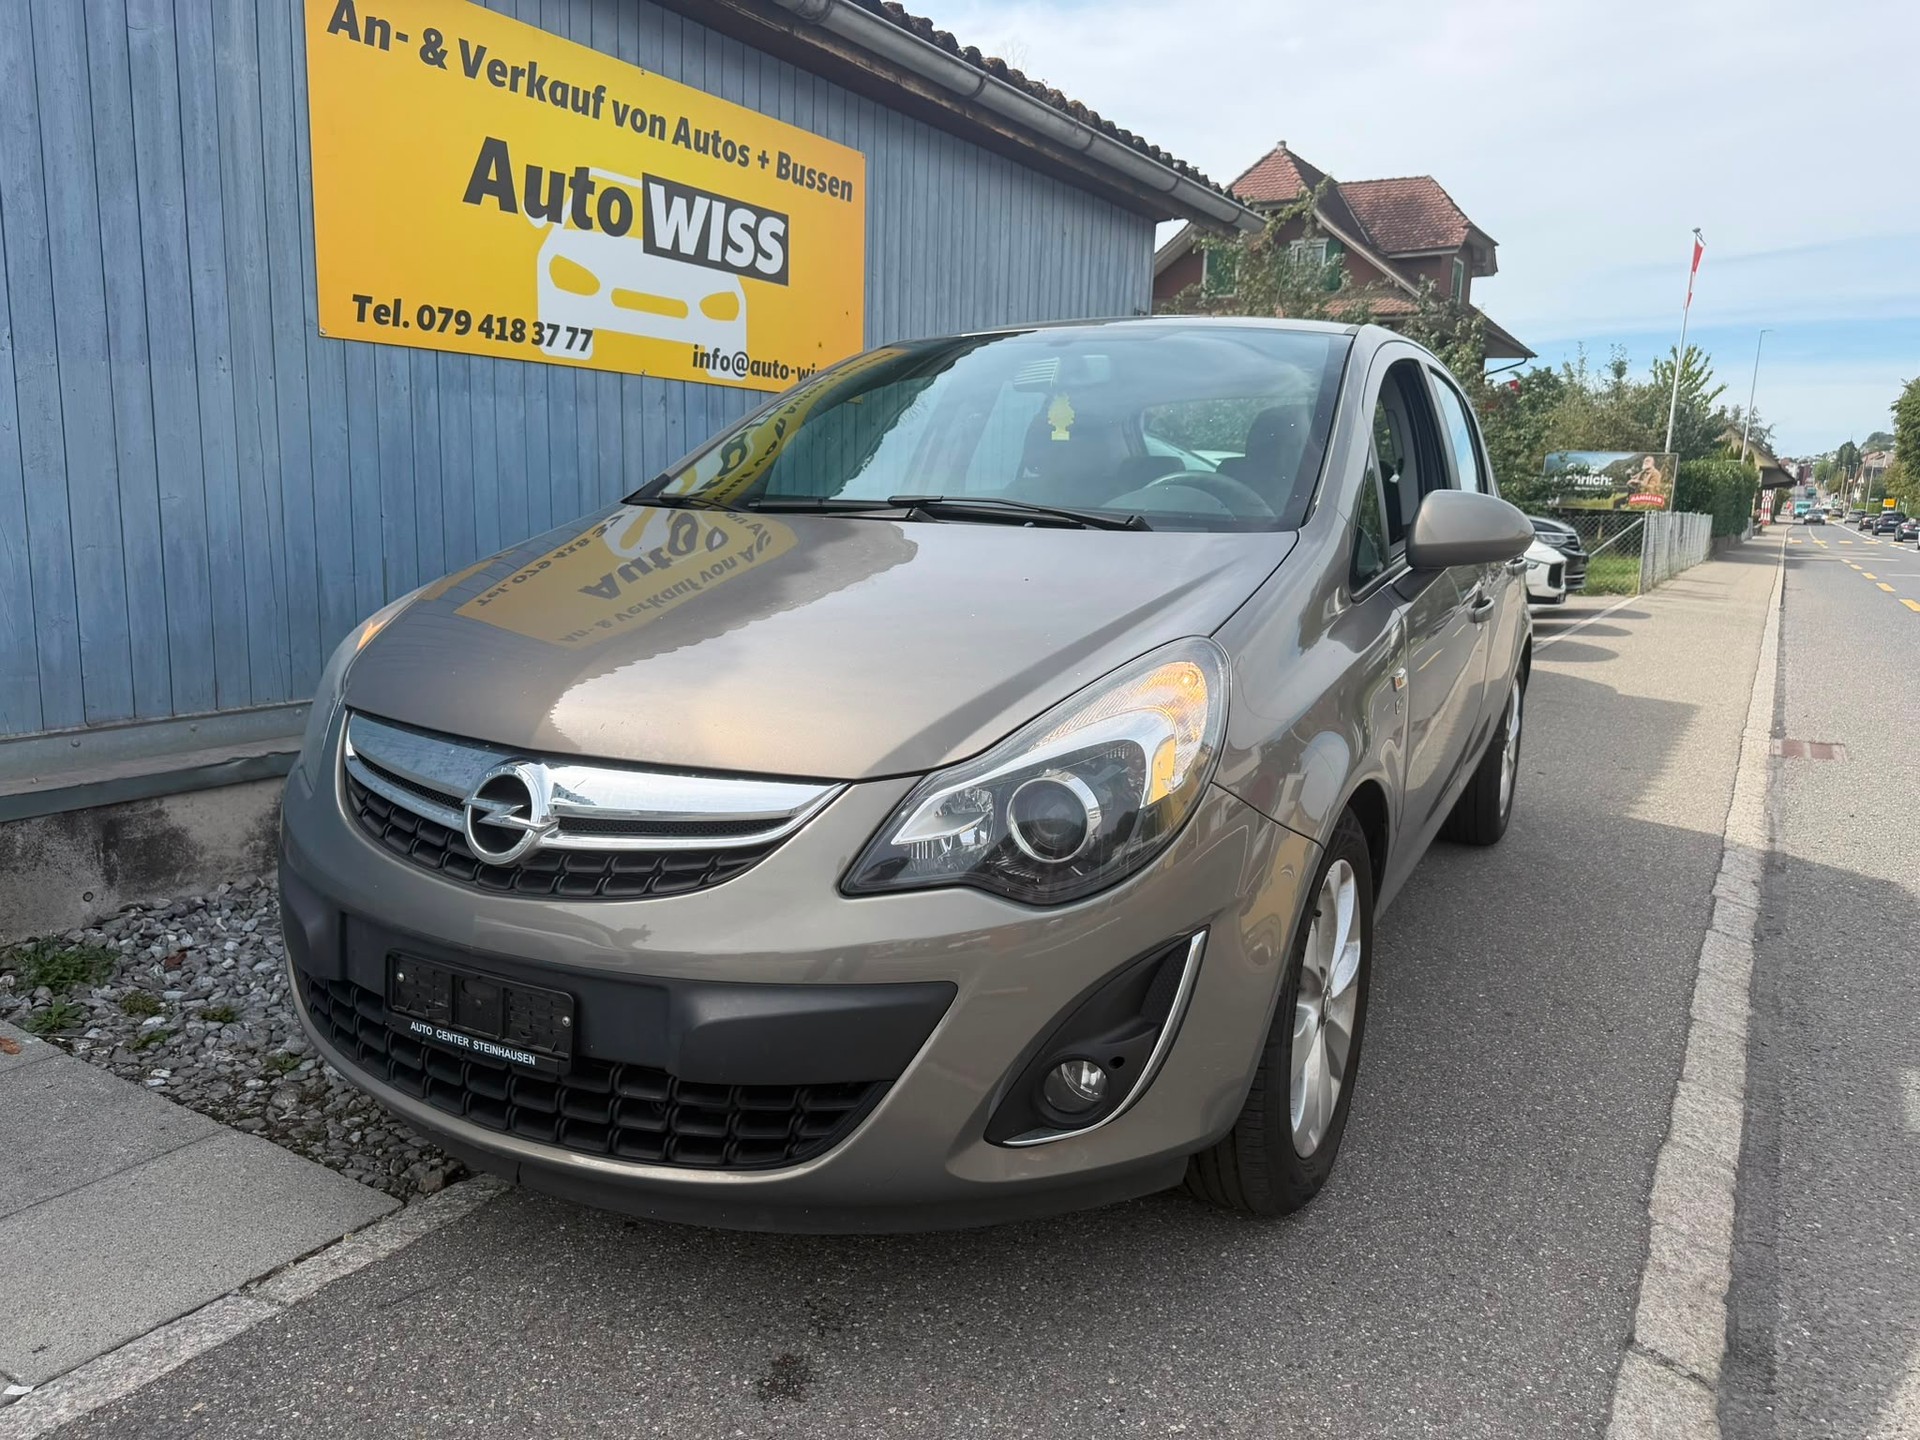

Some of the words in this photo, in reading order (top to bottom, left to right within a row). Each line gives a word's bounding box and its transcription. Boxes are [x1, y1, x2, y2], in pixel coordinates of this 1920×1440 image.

[327, 0, 408, 51] An-
[419, 28, 448, 70] &
[458, 38, 606, 119] Verkauf
[612, 99, 666, 141] von
[672, 116, 750, 168] Autos
[757, 150, 769, 170] +
[776, 151, 853, 202] Bussen
[462, 136, 633, 237] Auto
[648, 182, 786, 275] WISS
[352, 294, 410, 329] Tel.
[416, 304, 472, 336] 079
[478, 314, 527, 343] 418
[531, 321, 560, 347] 37
[565, 326, 593, 352] 77
[692, 344, 821, 382] info@auto-wi
[410, 1021, 432, 1036] AUTO
[436, 1029, 469, 1047] CENTER
[473, 1040, 536, 1066] STEINHAUSEN
